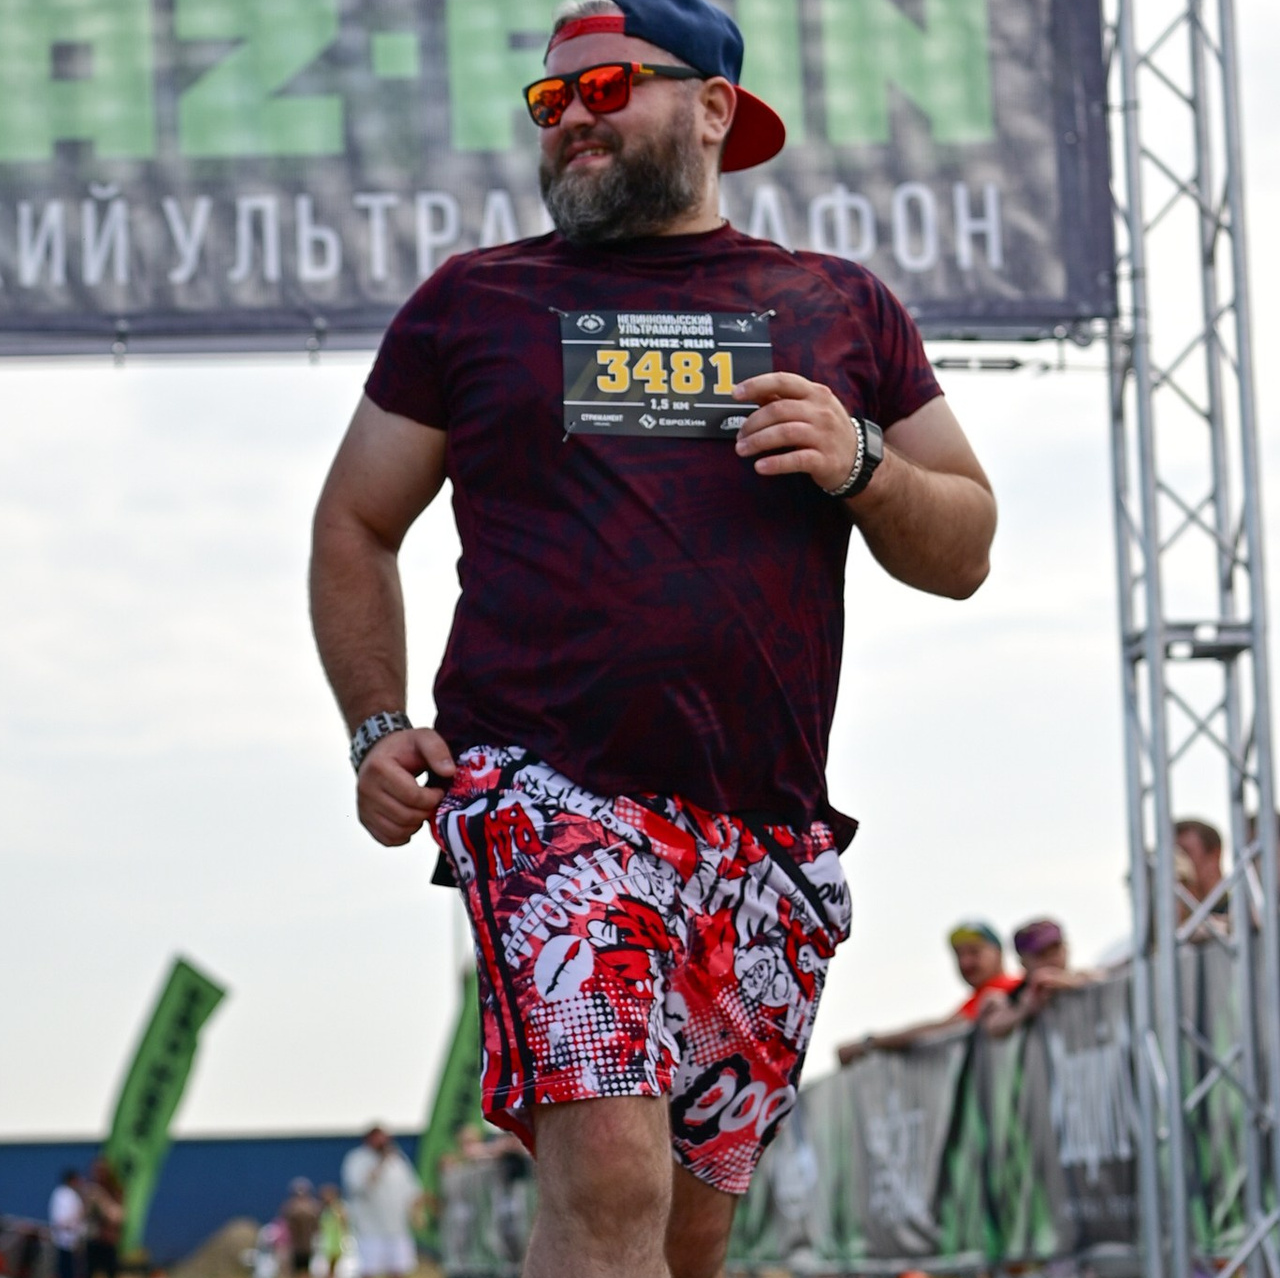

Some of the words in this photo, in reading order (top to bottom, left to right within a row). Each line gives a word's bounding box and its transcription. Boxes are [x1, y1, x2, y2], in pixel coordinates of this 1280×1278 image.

[162, 181, 1005, 283] УЛЬТРААФОН
[618, 324, 714, 336] УЛЬТРАМАРАФОН
[596, 349, 735, 395] 3481
